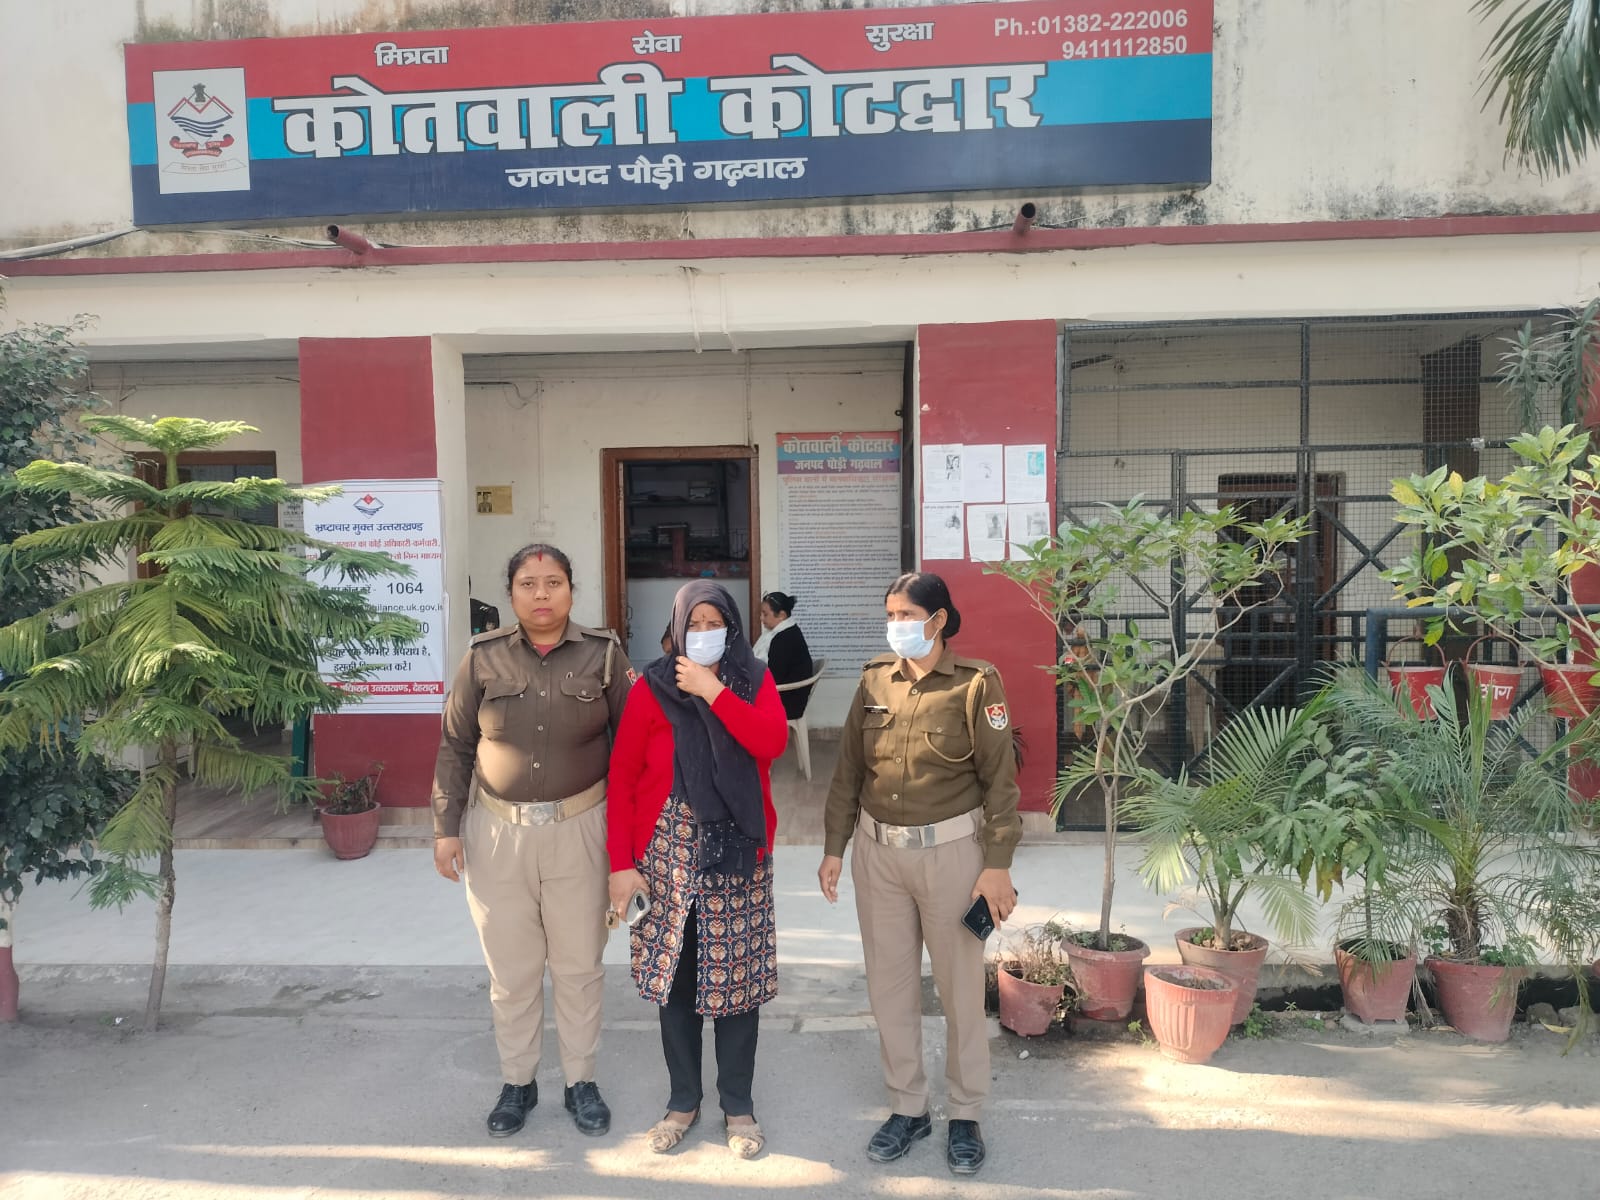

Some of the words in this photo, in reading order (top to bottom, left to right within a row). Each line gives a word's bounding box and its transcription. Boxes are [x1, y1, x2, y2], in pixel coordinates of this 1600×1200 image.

[994, 8, 1188, 38] Ph.:01382-222006
[374, 42, 450, 67] मित्रता
[632, 30, 682, 55] सेवा
[865, 20, 934, 51] सुरक्षा
[1062, 35, 1188, 60] 9411112850
[272, 61, 685, 159] कोतवाली
[709, 54, 1047, 141] कोटद्वार
[505, 161, 611, 189] जनपद
[621, 154, 685, 190] पौड़ी
[692, 157, 808, 187] गढ़वाल
[783, 435, 842, 453] कोतवाली
[387, 582, 424, 595] 1064
